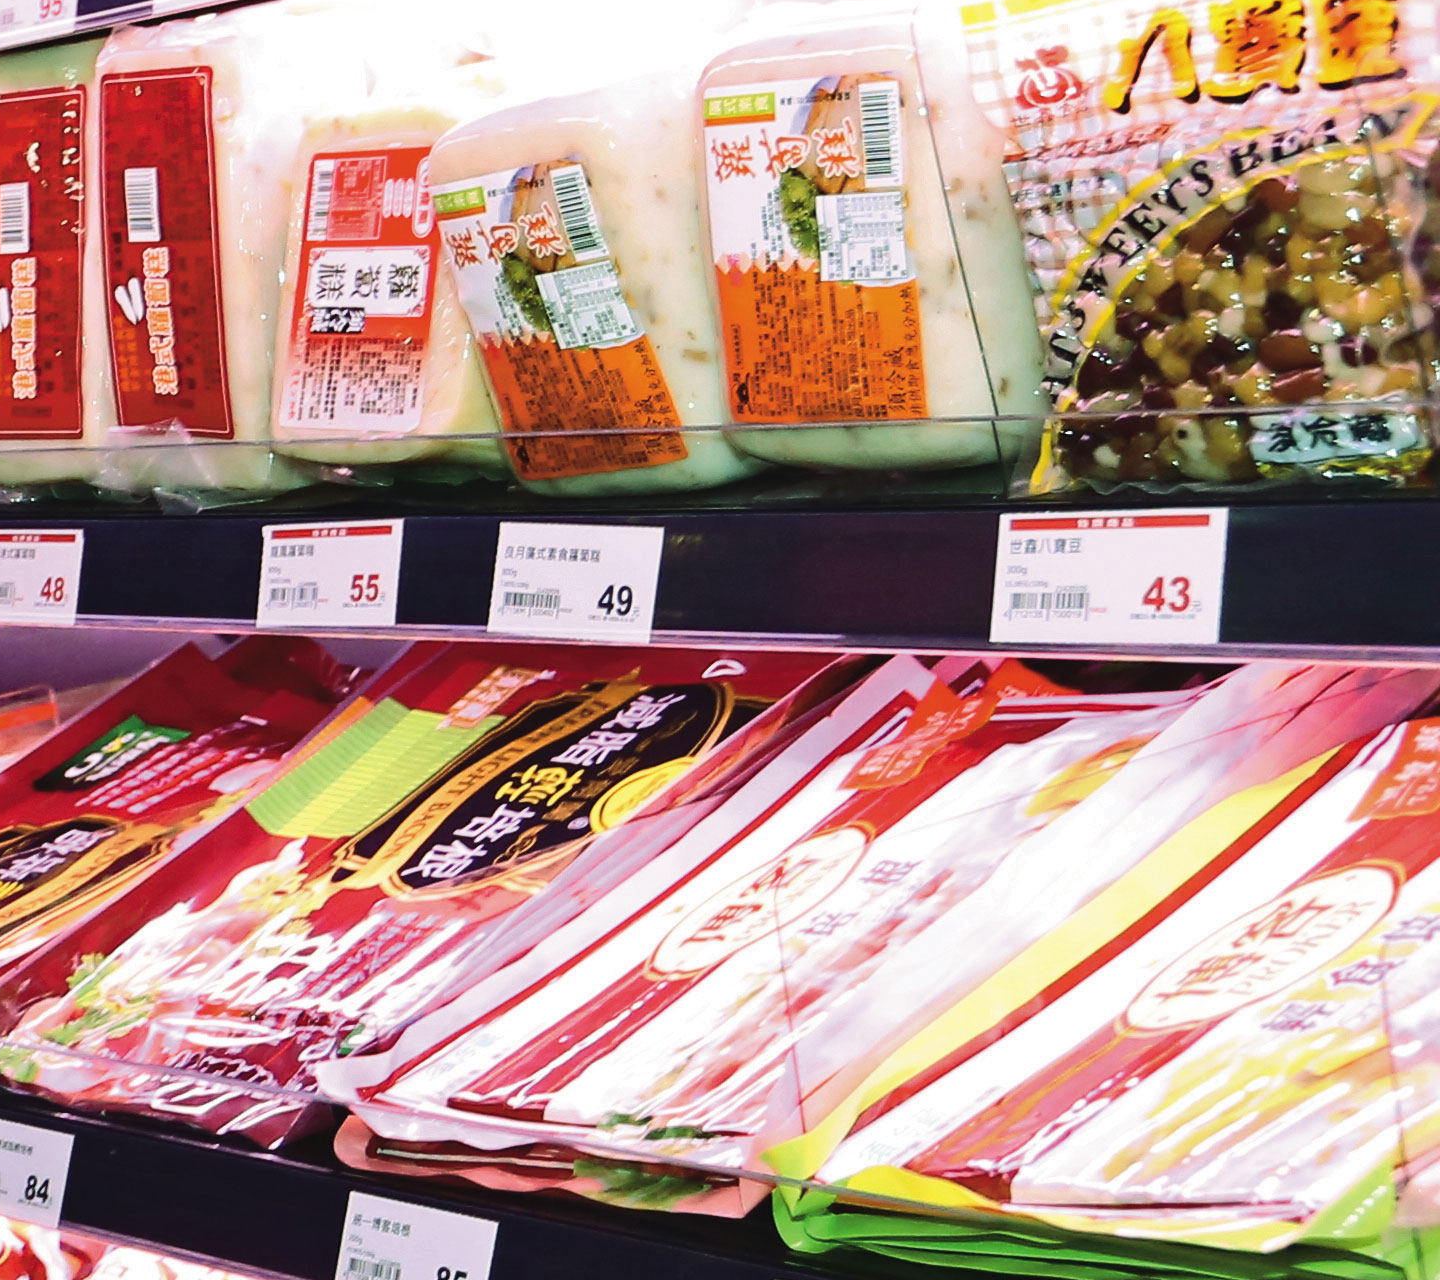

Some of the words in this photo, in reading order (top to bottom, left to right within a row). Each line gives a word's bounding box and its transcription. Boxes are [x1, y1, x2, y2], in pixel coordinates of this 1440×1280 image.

[710, 116, 866, 184] 蘿蔔糕
[40, 576, 66, 603] 48
[349, 573, 380, 602] 55
[596, 584, 634, 617] 49
[1142, 576, 1191, 613] 43
[23, 1174, 51, 1204] 84
